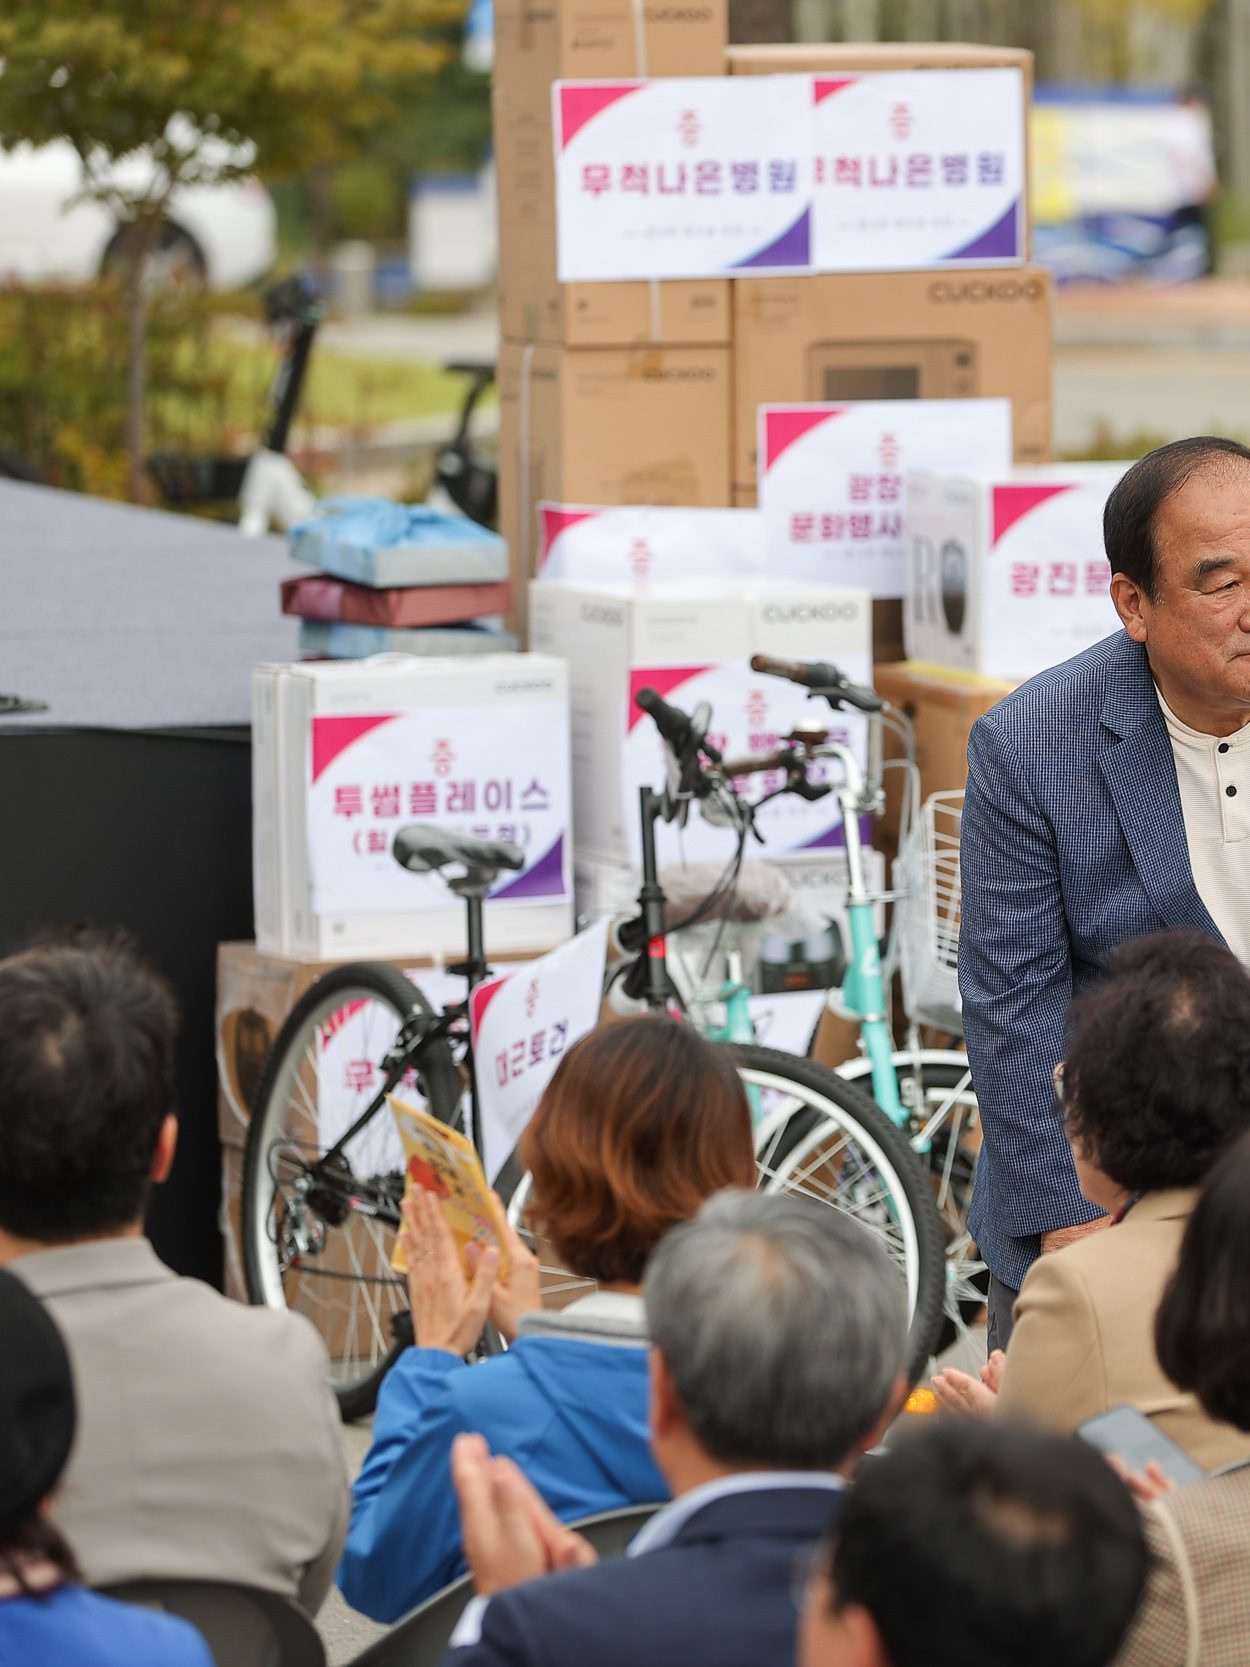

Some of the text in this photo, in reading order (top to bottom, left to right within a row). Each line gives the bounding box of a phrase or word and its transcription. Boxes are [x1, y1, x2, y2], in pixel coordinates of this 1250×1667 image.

[677, 110, 702, 146] 증
[890, 104, 913, 140] 증
[582, 159, 797, 197] 무척나은병원
[928, 281, 1045, 305] CUCKOO
[763, 602, 858, 625] CUCKOO
[430, 739, 456, 777] 증
[334, 778, 549, 820] 투썸플레이스
